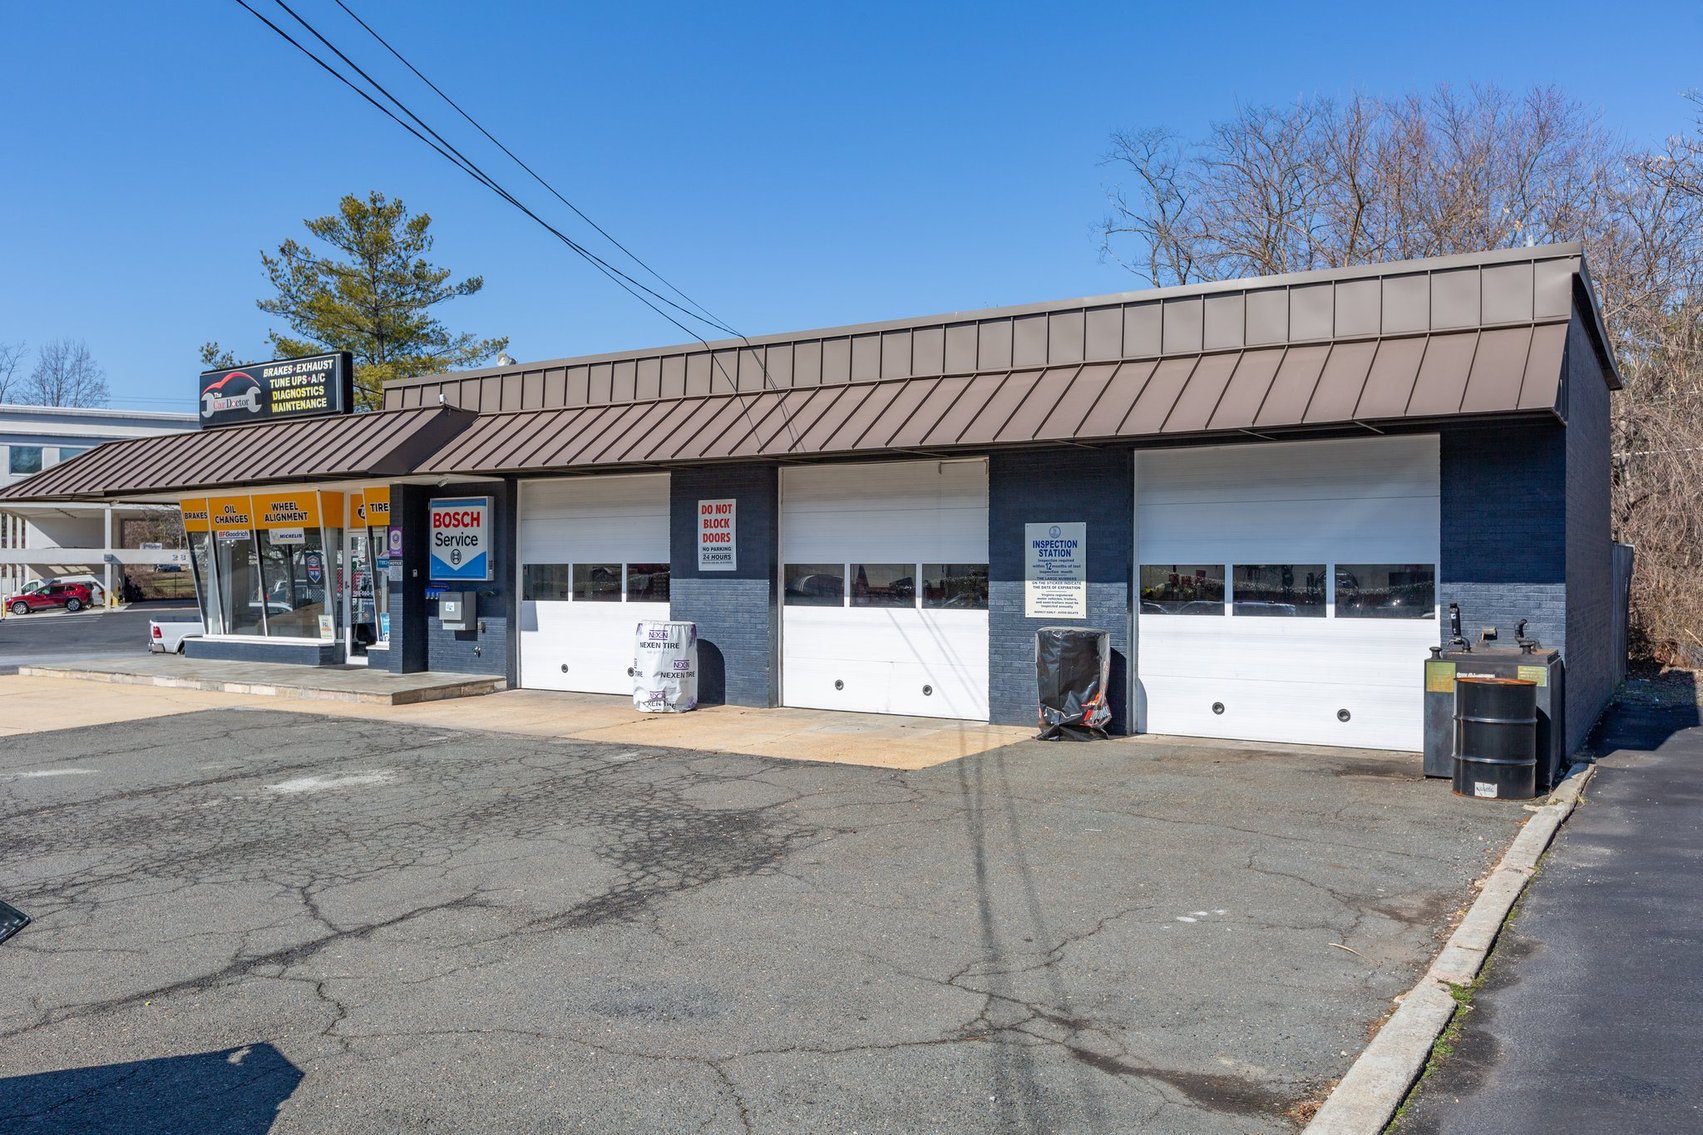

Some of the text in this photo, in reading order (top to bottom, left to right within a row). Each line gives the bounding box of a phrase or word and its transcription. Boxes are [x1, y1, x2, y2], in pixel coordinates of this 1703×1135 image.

[263, 360, 333, 378] BRAKES EXHAUST
[270, 373, 326, 388] TUNE UPS A/C
[272, 386, 324, 400] DIAGNOSTICS
[213, 398, 249, 410] Car Doctor
[272, 398, 327, 413] MAINTENANCE
[224, 506, 236, 514] OIL
[272, 502, 298, 511] WHEEL
[702, 504, 732, 514] DO NOT
[184, 512, 208, 520] BRAKES
[214, 515, 248, 524] CHANGES
[264, 512, 308, 522] ALIGNMENT
[433, 512, 480, 528] BOSCH
[704, 519, 730, 529] BLOCK
[435, 532, 478, 547] Service
[703, 533, 731, 543] DOORS
[1032, 540, 1078, 548] INSPECTION
[1039, 549, 1071, 557] STATION
[1045, 562, 1052, 570] 12
